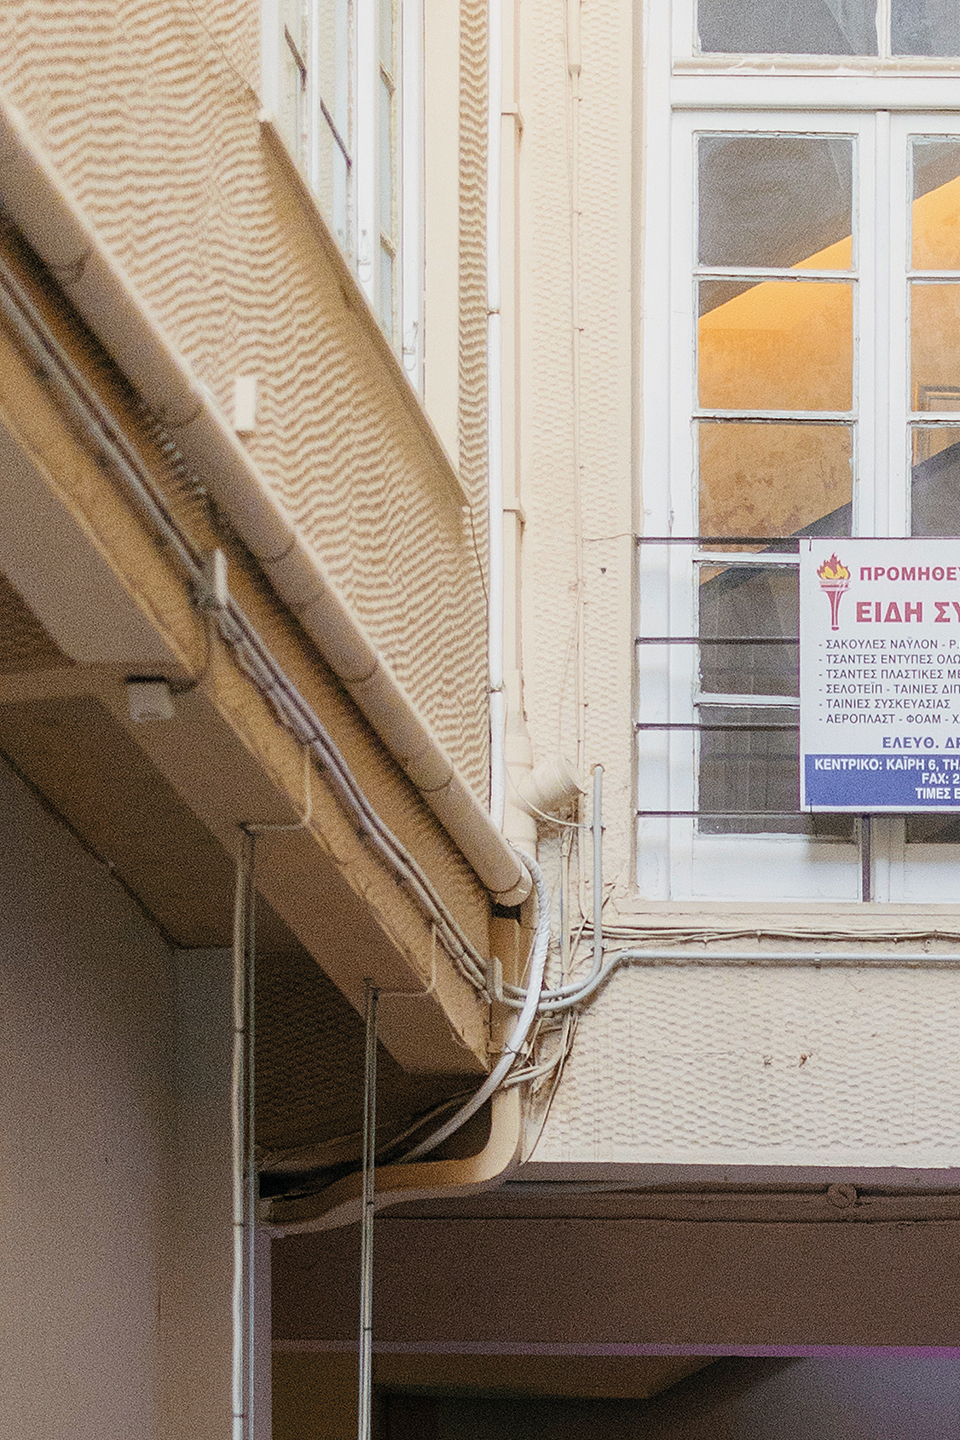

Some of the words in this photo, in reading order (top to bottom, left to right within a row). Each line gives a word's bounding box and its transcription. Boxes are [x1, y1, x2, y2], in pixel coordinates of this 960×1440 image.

[855, 601, 923, 624] ΕΙΔΗ
[825, 638, 887, 650] ΣΑΚΟΥΛΕΣ
[825, 653, 878, 665] ΤΣΑΝΤΕΣ
[880, 653, 934, 665] ΕΝΤΥΠΕΣ
[825, 668, 878, 680] ΤΣΑΝΤΕΣ
[880, 668, 944, 680] ΠΛΑΣΤΙΚΕΣ
[893, 683, 939, 695] ΤΑΙΝΙΕΣ
[825, 698, 871, 709] ΤΑΙΝΙΕΣ
[874, 698, 951, 709] ΣΥΣΚΕΥΑΣΙΑΣ
[825, 713, 896, 725] ΑΕΡΟΠΛΑΣΤ
[905, 713, 942, 725] ΦΟΑΜ
[882, 736, 940, 749] ΕΛΕΥΘ.
[814, 757, 883, 771] ΚΕΝΤΡΙΚΟ:
[927, 758, 940, 773] 6,
[921, 773, 949, 785] FAX:
[914, 787, 952, 800] ΤΙΜΕΣ
